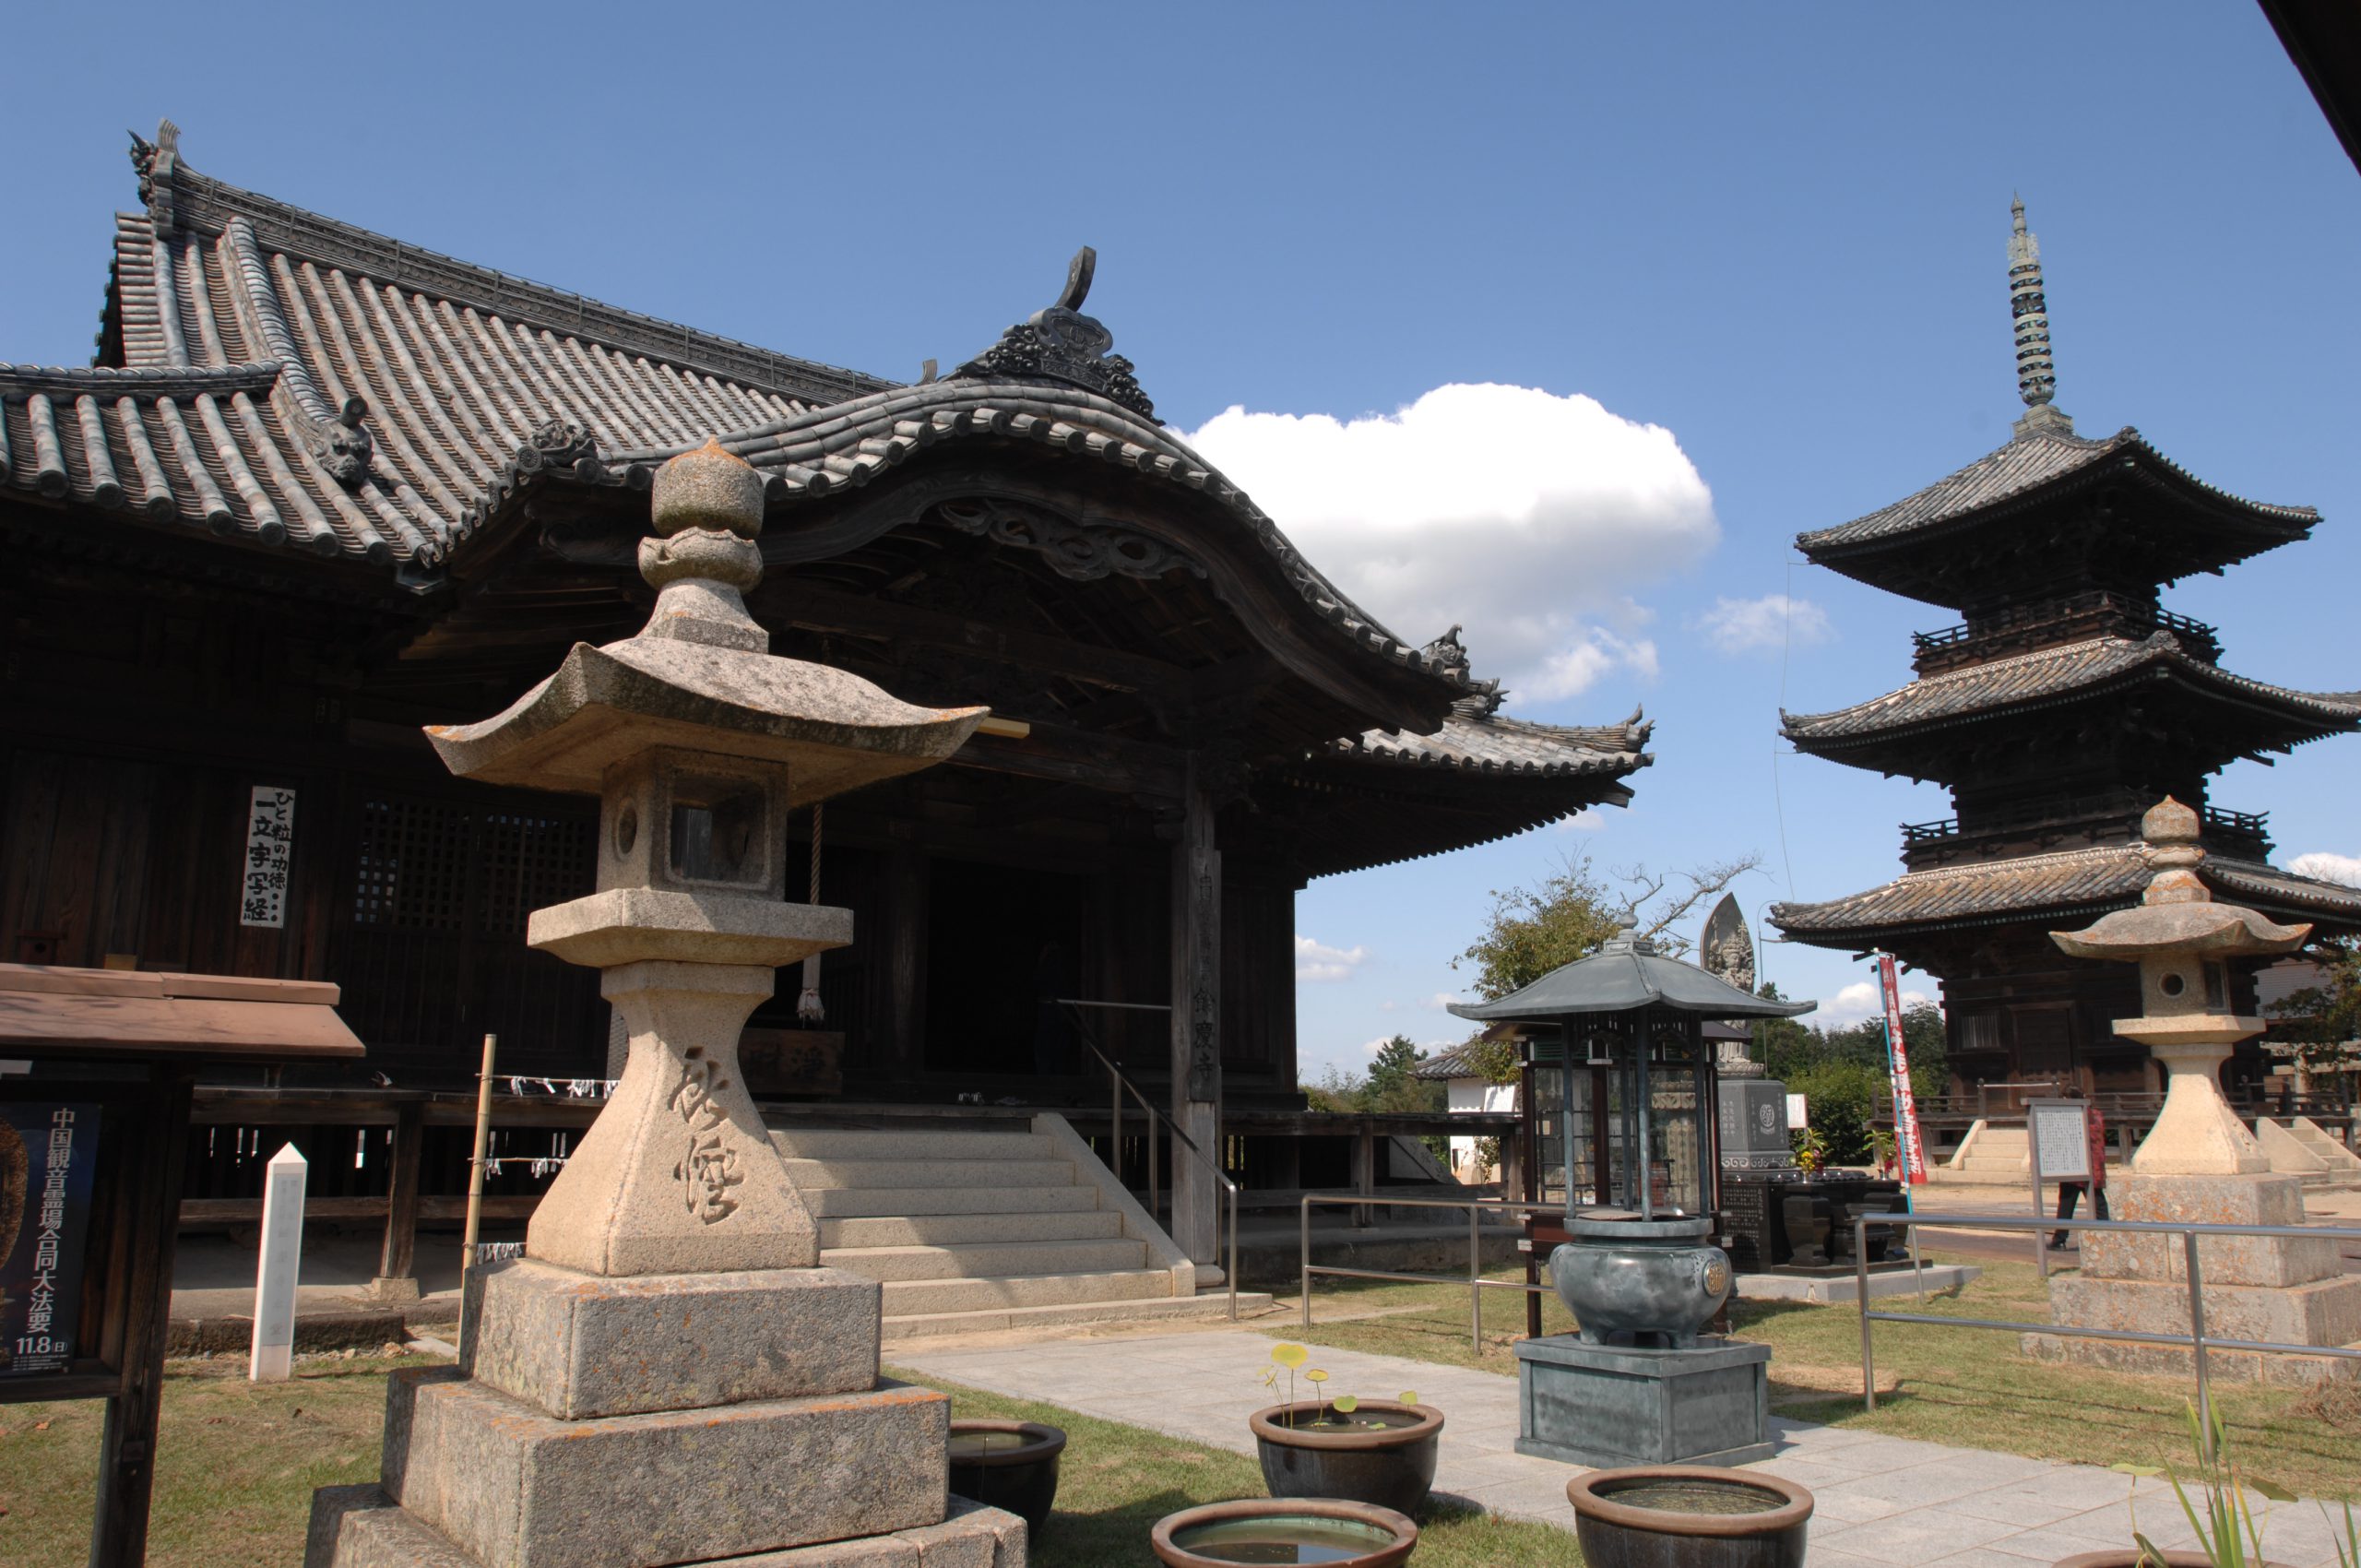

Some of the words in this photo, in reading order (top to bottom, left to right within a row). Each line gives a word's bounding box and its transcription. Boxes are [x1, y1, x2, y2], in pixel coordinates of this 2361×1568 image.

[243, 800, 277, 921] 一文字写経
[27, 1108, 76, 1334] 中国観音霊場合同大法要
